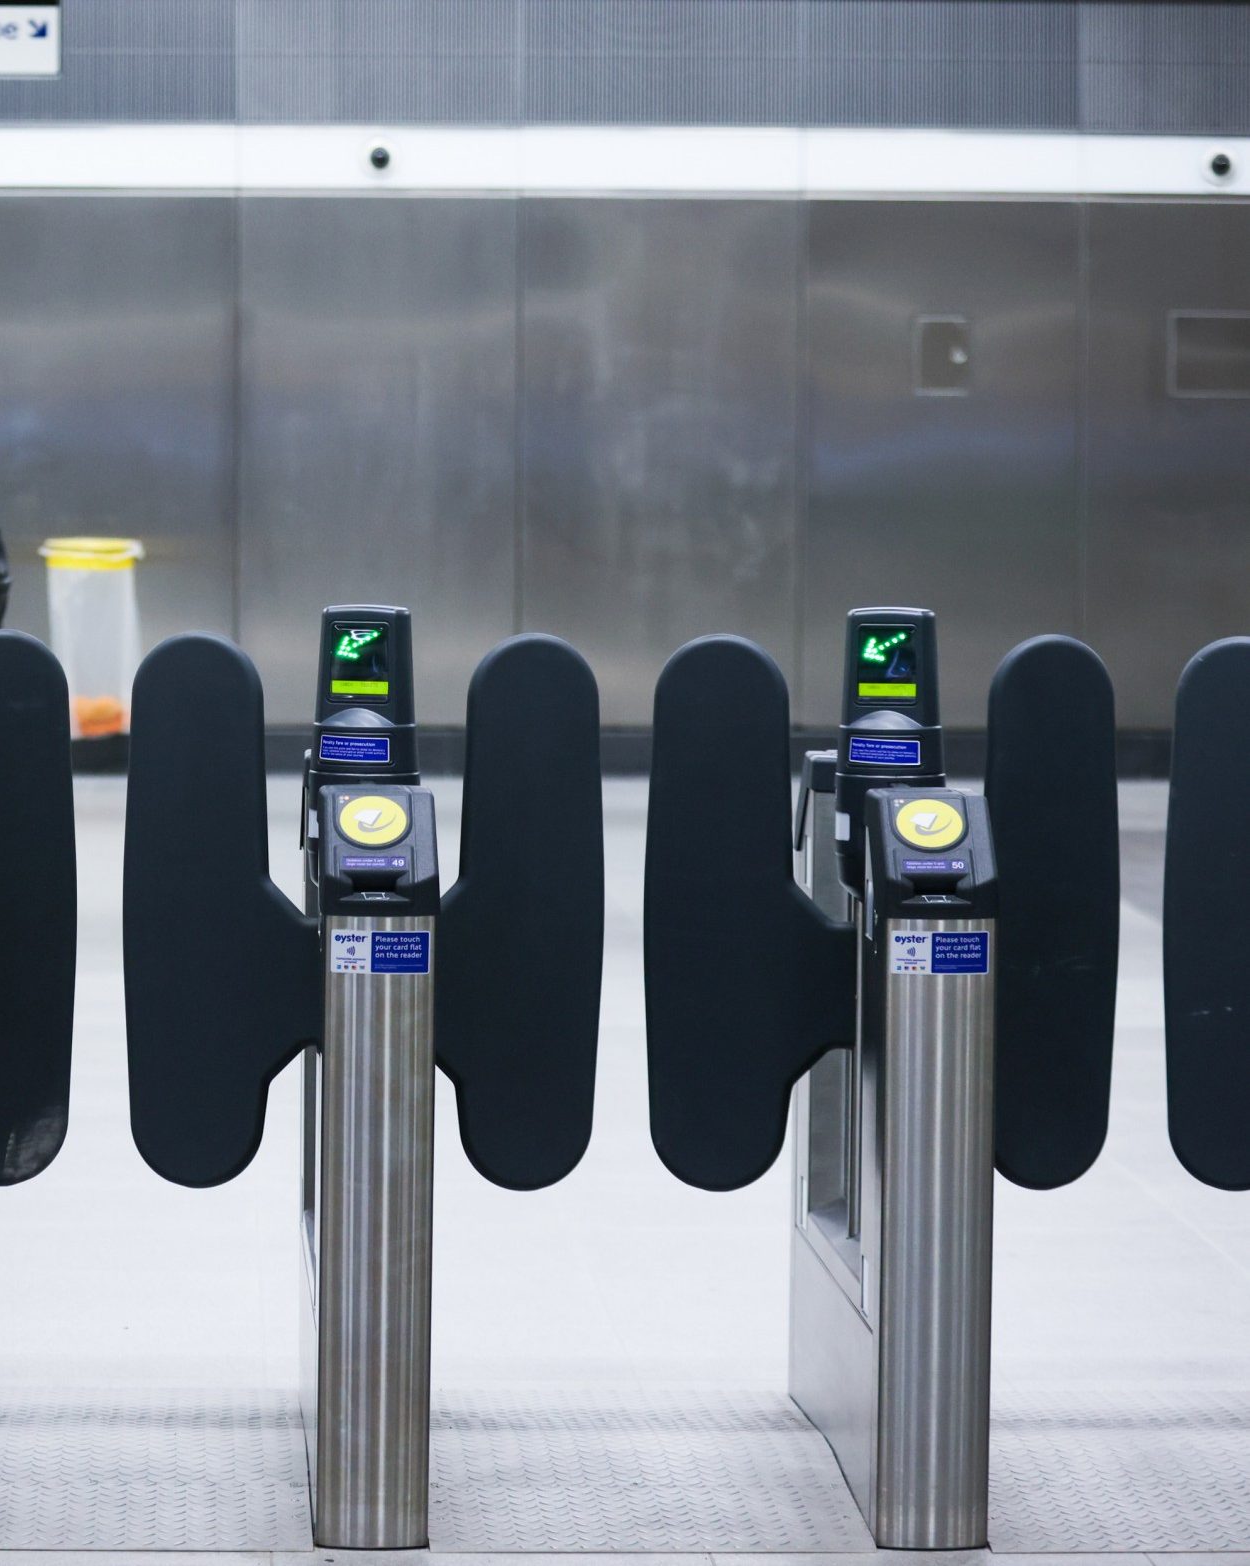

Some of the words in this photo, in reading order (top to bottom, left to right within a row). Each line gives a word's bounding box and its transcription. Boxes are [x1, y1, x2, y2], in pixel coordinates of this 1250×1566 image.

[391, 859, 404, 867] 49
[952, 861, 964, 869] 50
[335, 934, 366, 943] oyster
[895, 935, 926, 944] oyster
